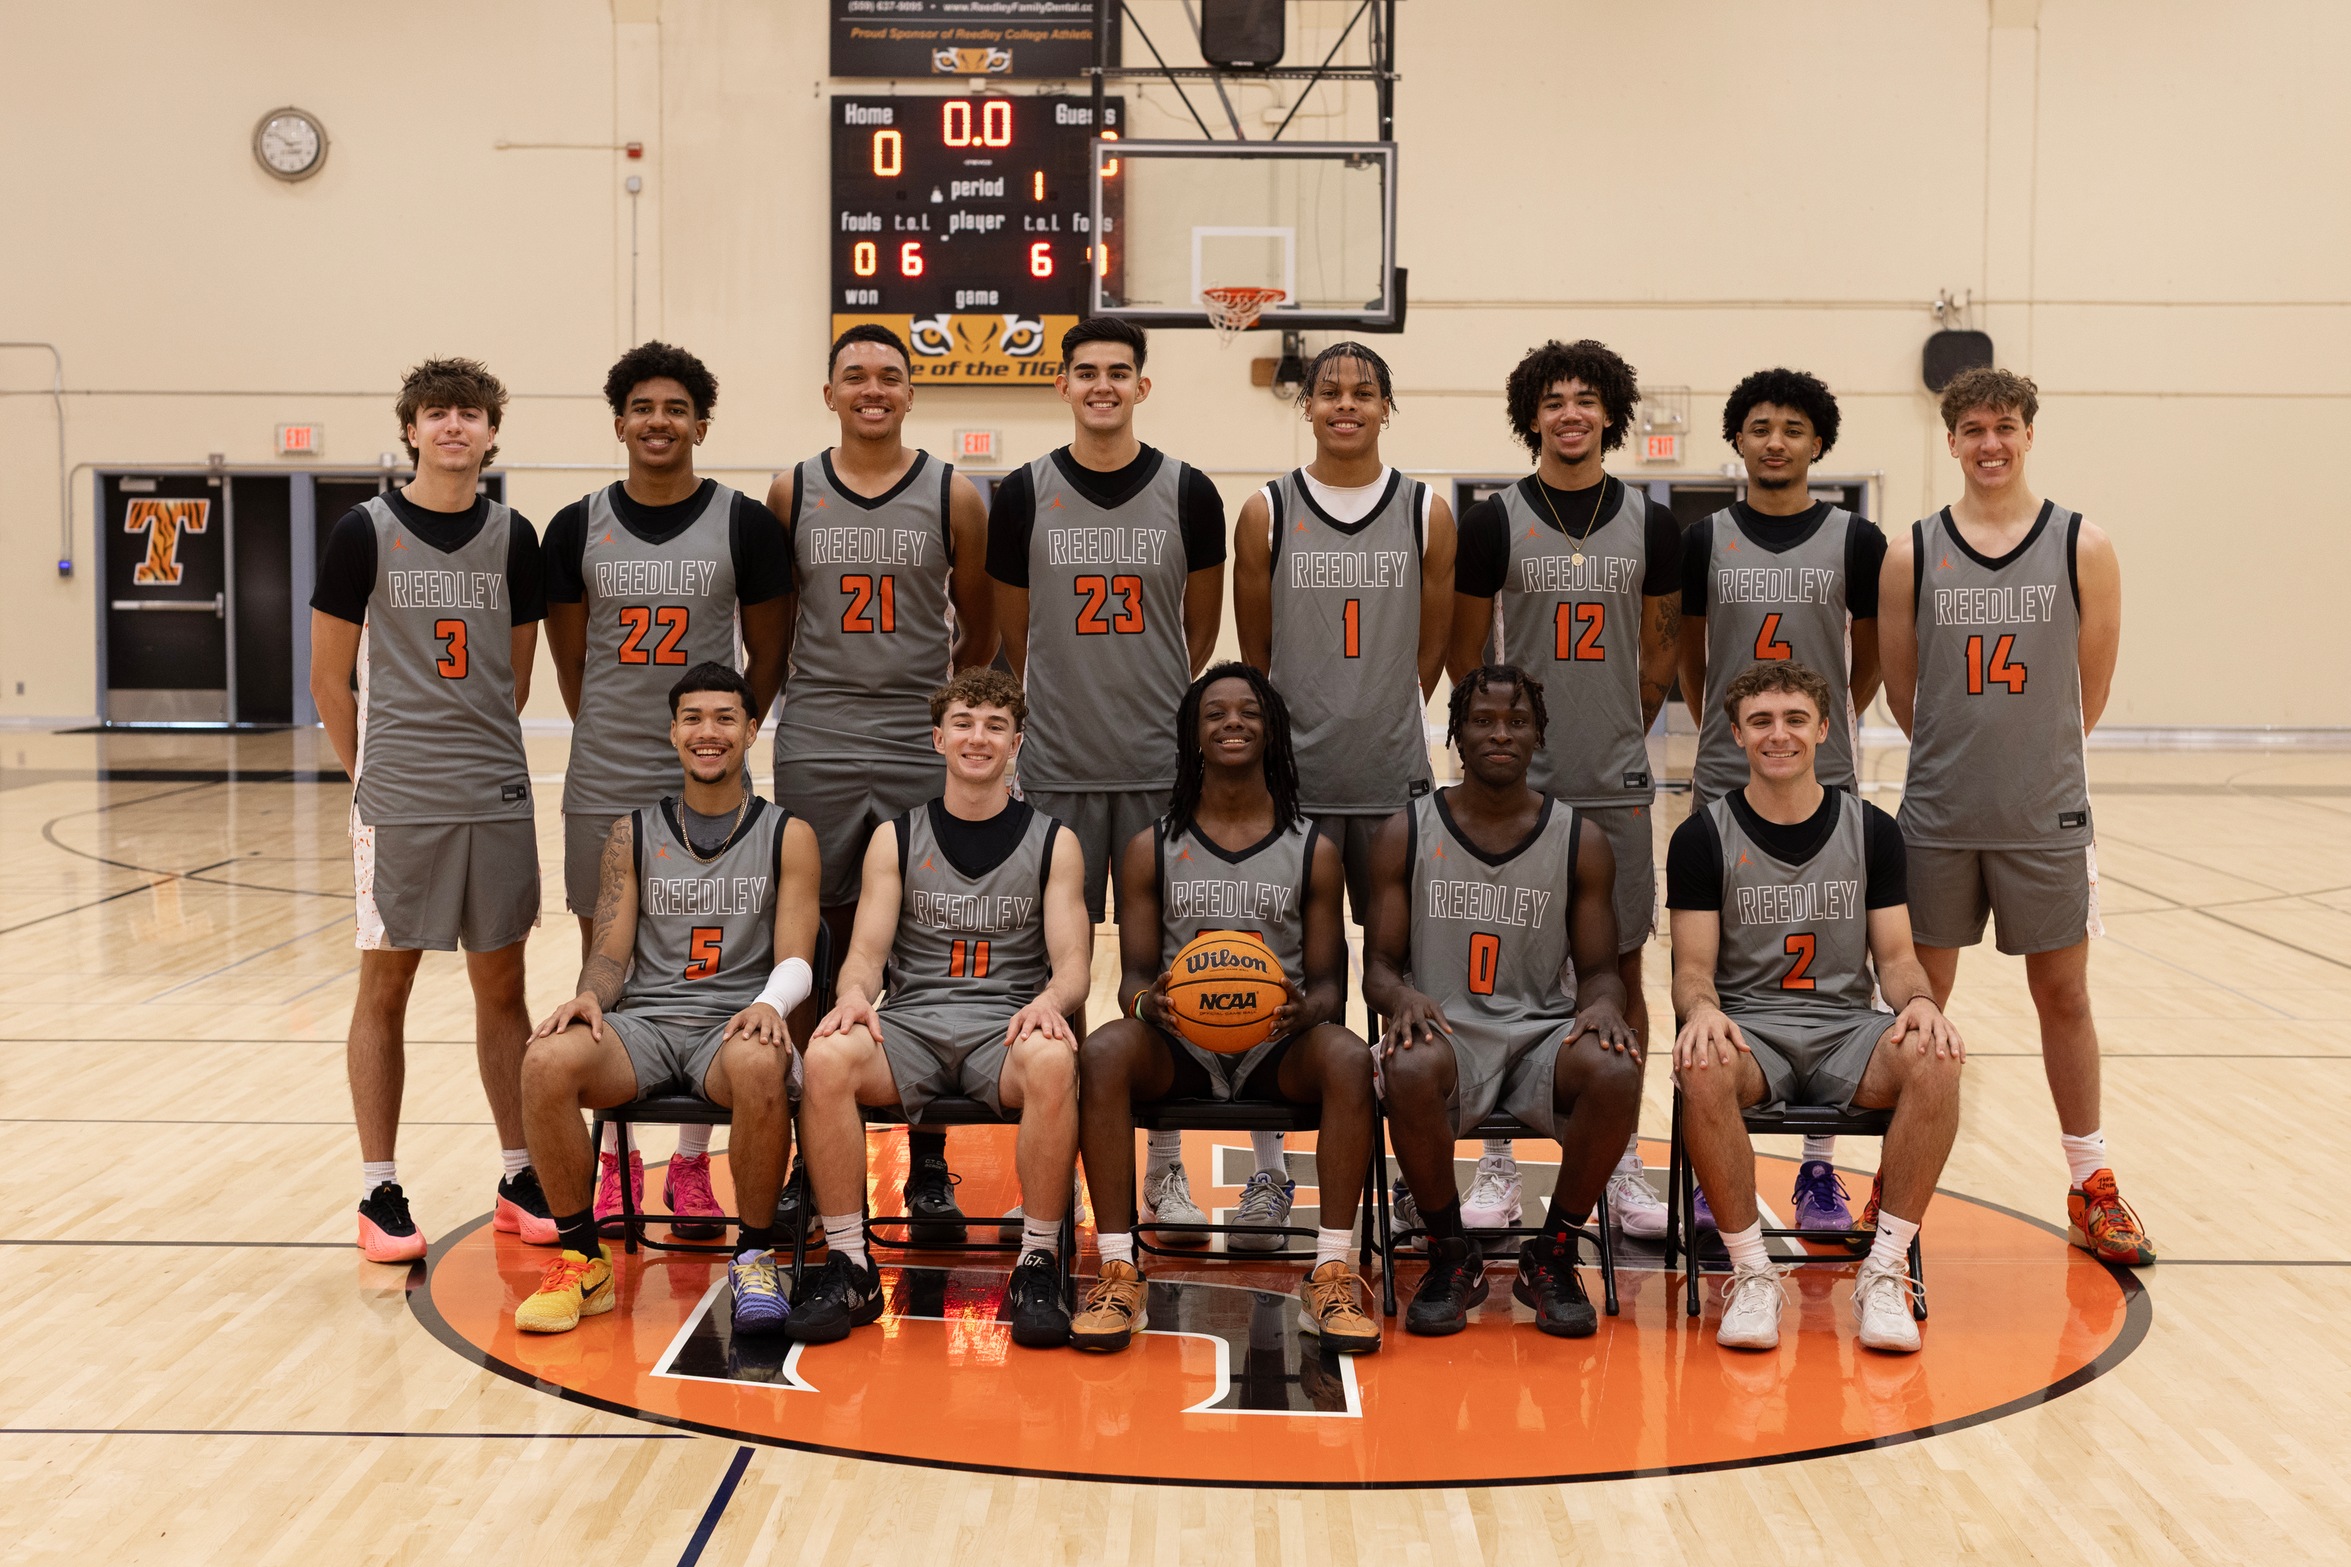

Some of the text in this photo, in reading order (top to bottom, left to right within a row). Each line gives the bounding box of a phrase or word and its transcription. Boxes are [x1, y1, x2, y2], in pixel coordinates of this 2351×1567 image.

[850, 27, 1093, 42] Proud Sponsor of Reedley College Athletic
[845, 104, 893, 124] Home
[943, 101, 1011, 147] 0.0
[1056, 103, 1116, 125] Gues
[873, 130, 901, 176] 0
[951, 177, 1004, 201] period
[1034, 171, 1044, 201] 1
[841, 211, 882, 231] fouls
[949, 209, 1006, 234] player
[1073, 212, 1113, 232] fos
[854, 241, 876, 276] 0
[901, 241, 924, 277] 6
[1030, 243, 1053, 277] 6
[845, 289, 879, 305] won
[955, 290, 999, 310] game
[931, 361, 962, 376] of
[965, 361, 1009, 377] the
[285, 427, 312, 449] EXIT
[964, 432, 990, 455] EXIT
[1648, 435, 1674, 458] EXIT
[124, 498, 211, 585] T
[810, 528, 927, 567] REEDLEY
[1048, 527, 1167, 566] REEDLEY
[595, 560, 717, 598] REEDLEY
[1291, 551, 1408, 588] REEDLEY
[1521, 555, 1637, 595] REEDLEY
[1717, 568, 1835, 605] REEDLEY
[388, 570, 502, 610] REEDLEY
[840, 573, 896, 634] 21
[1074, 574, 1146, 635] 23
[1934, 584, 2057, 626] REEDLEY
[618, 606, 689, 666] 22
[1342, 598, 1361, 659] 1
[1553, 601, 1605, 662] 12
[1754, 612, 1793, 661] 4
[434, 619, 469, 679] 3
[1964, 633, 2028, 695] 14
[647, 876, 767, 916] REEDLEY
[912, 889, 1033, 934] REEDLEY
[1171, 879, 1291, 923] REEDLEY
[1429, 879, 1551, 929] REEDLEY
[1736, 880, 1858, 925] REEDLEY
[683, 926, 724, 981] 5
[948, 939, 991, 979] 11
[1186, 948, 1268, 974] Wilson
[1468, 931, 1501, 997] 0
[1780, 932, 1817, 991] 2
[1199, 992, 1257, 1010] NCAA
